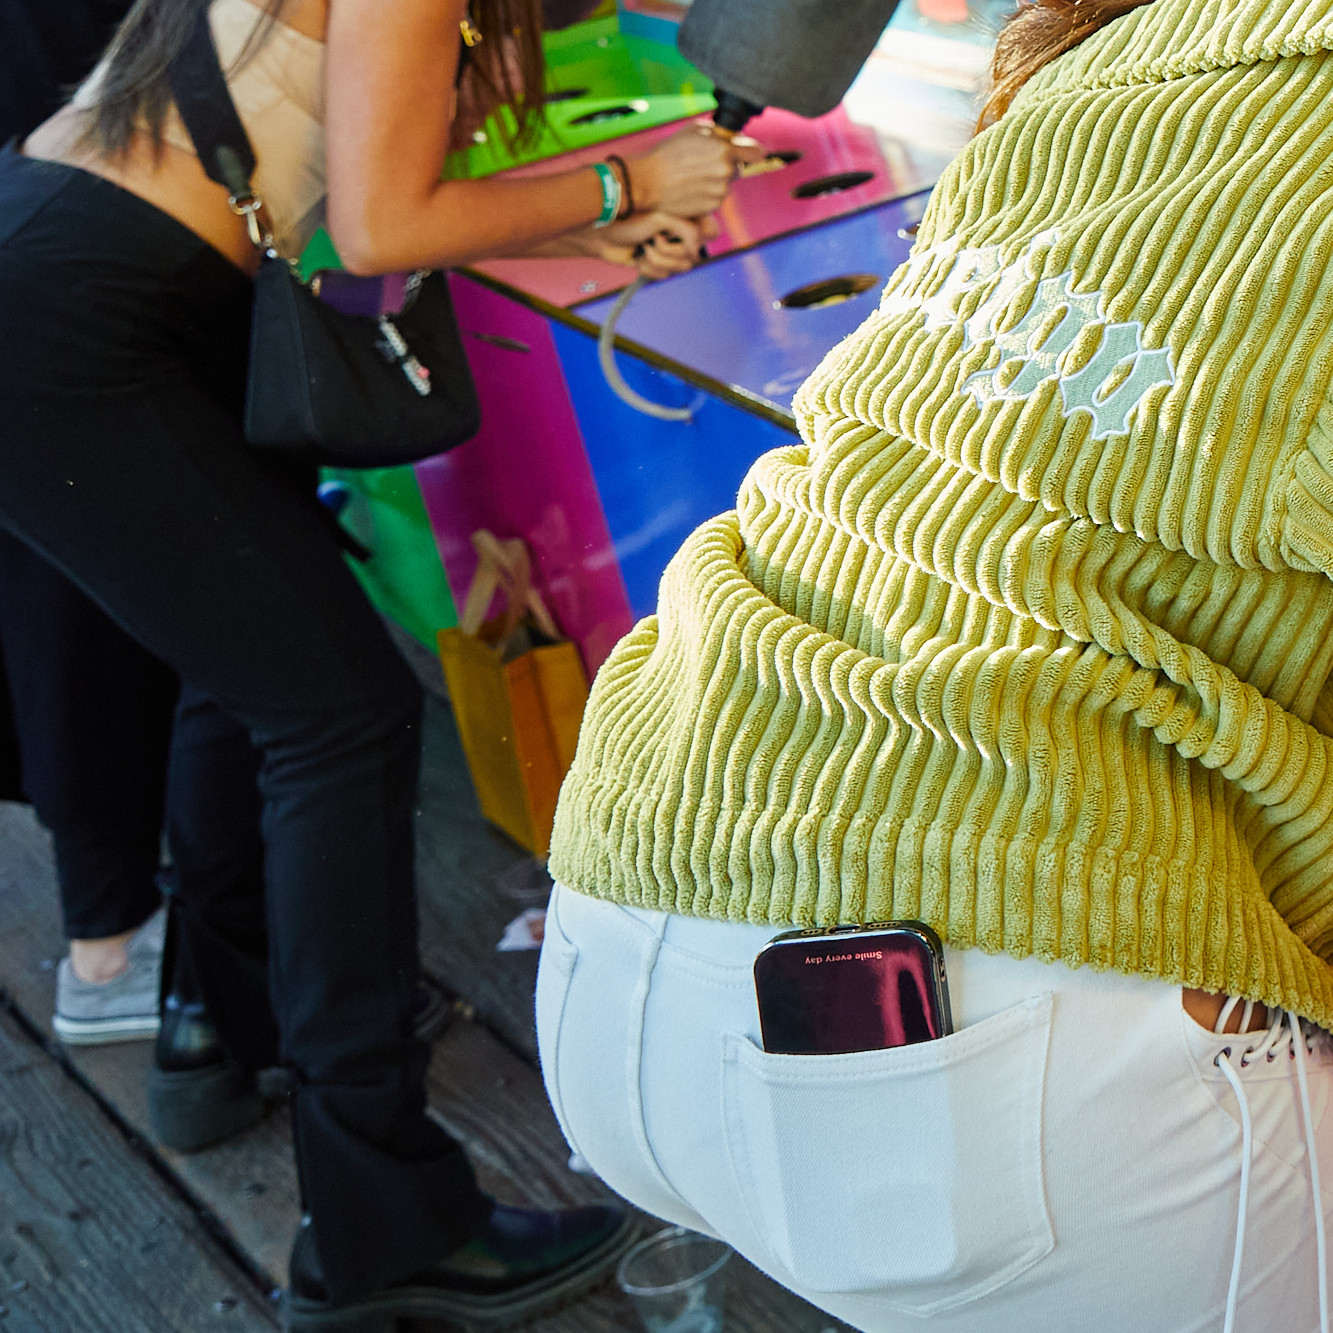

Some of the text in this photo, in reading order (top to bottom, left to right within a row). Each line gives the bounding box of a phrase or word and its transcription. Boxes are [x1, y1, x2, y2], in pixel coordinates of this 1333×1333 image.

[805, 950, 883, 965] Smile every day
